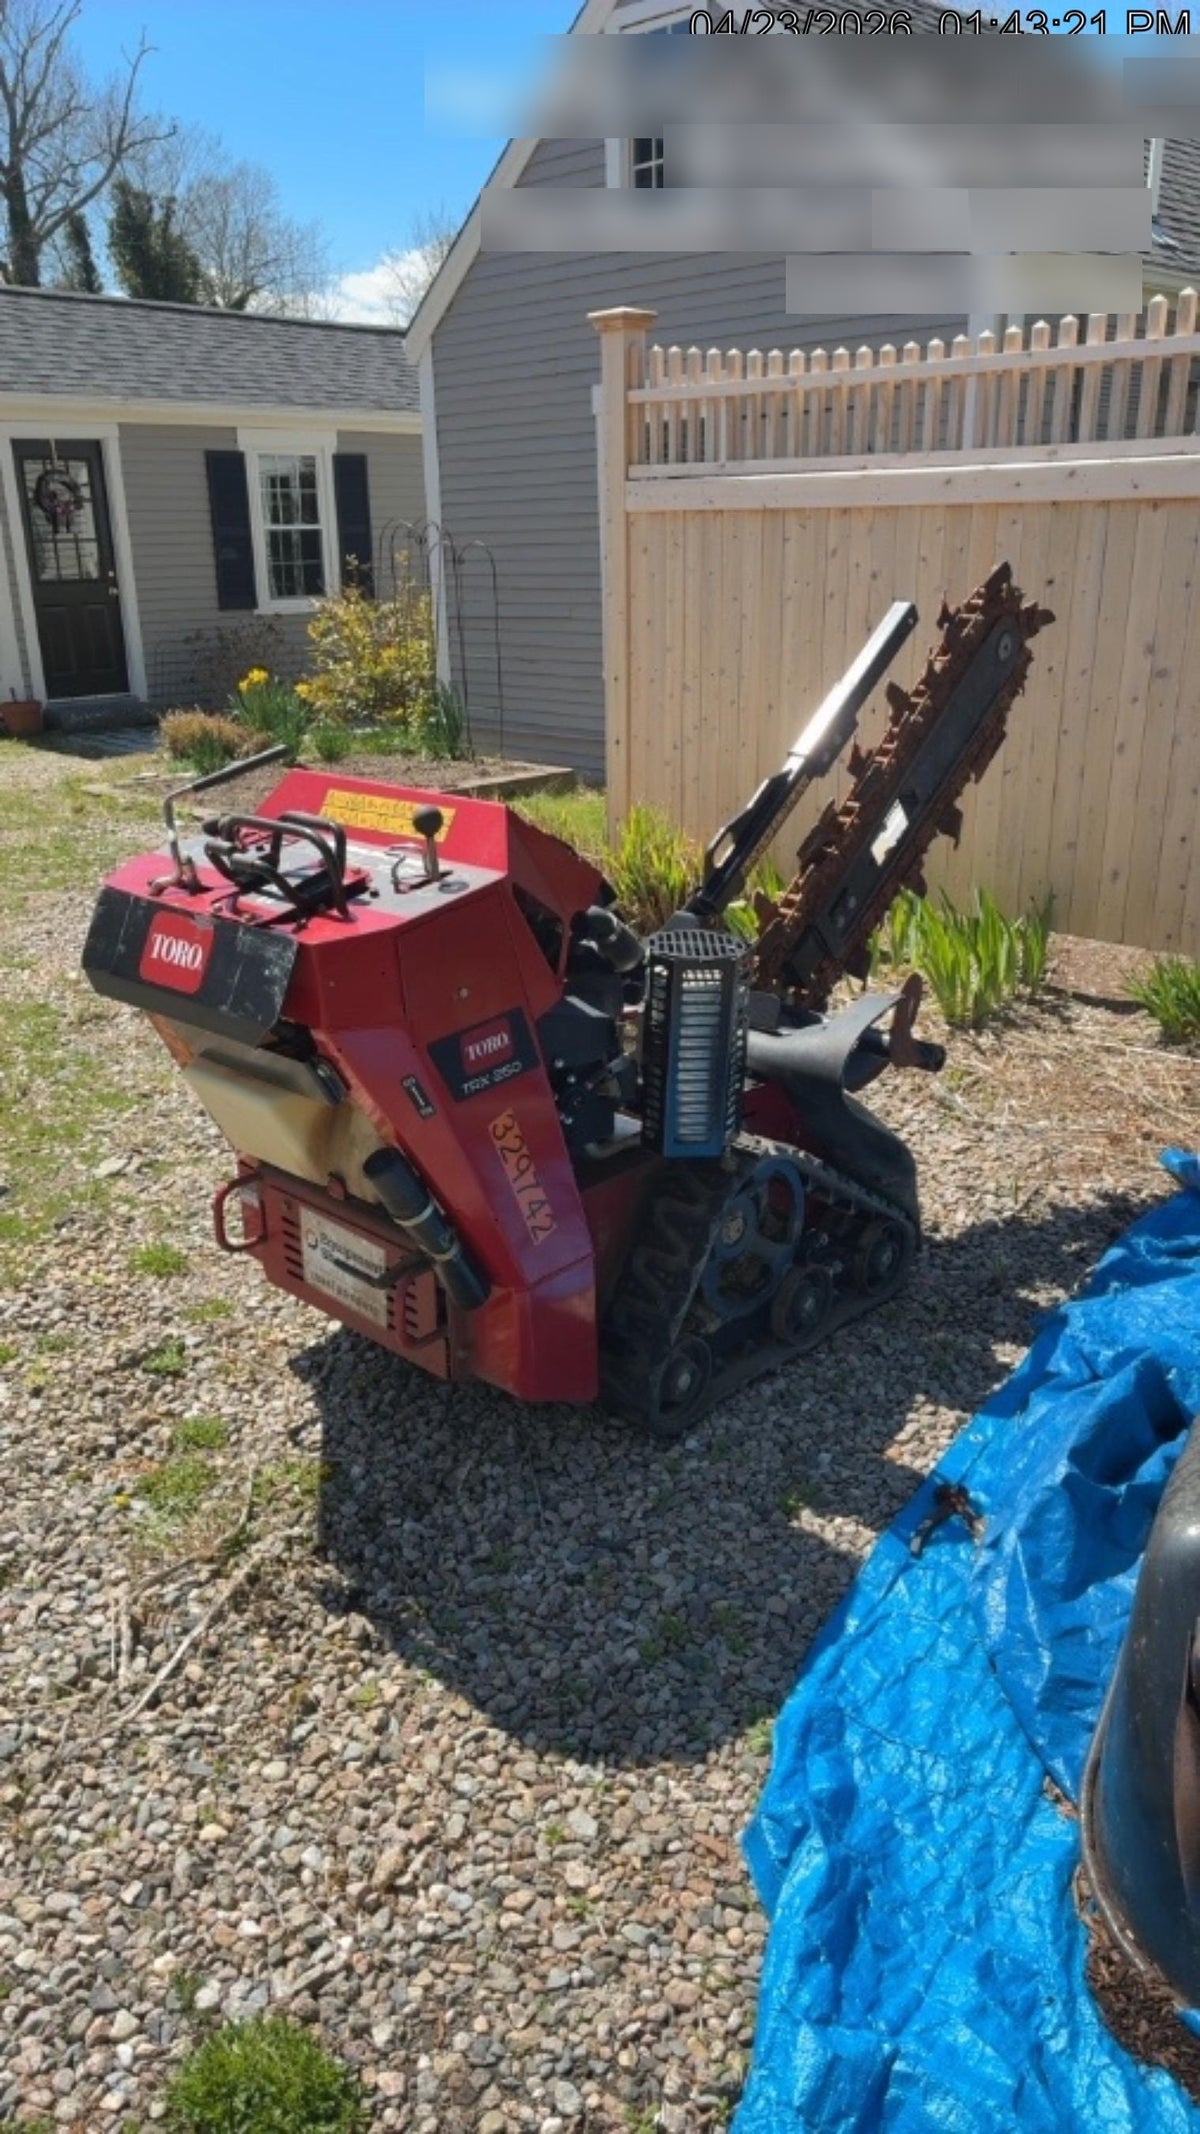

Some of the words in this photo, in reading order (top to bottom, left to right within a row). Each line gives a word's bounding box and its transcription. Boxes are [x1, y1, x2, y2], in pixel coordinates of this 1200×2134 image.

[150, 932, 203, 971] TORO
[465, 1032, 510, 1062] TORO
[462, 1071, 490, 1095] TRX
[491, 1112, 557, 1237] 329742
